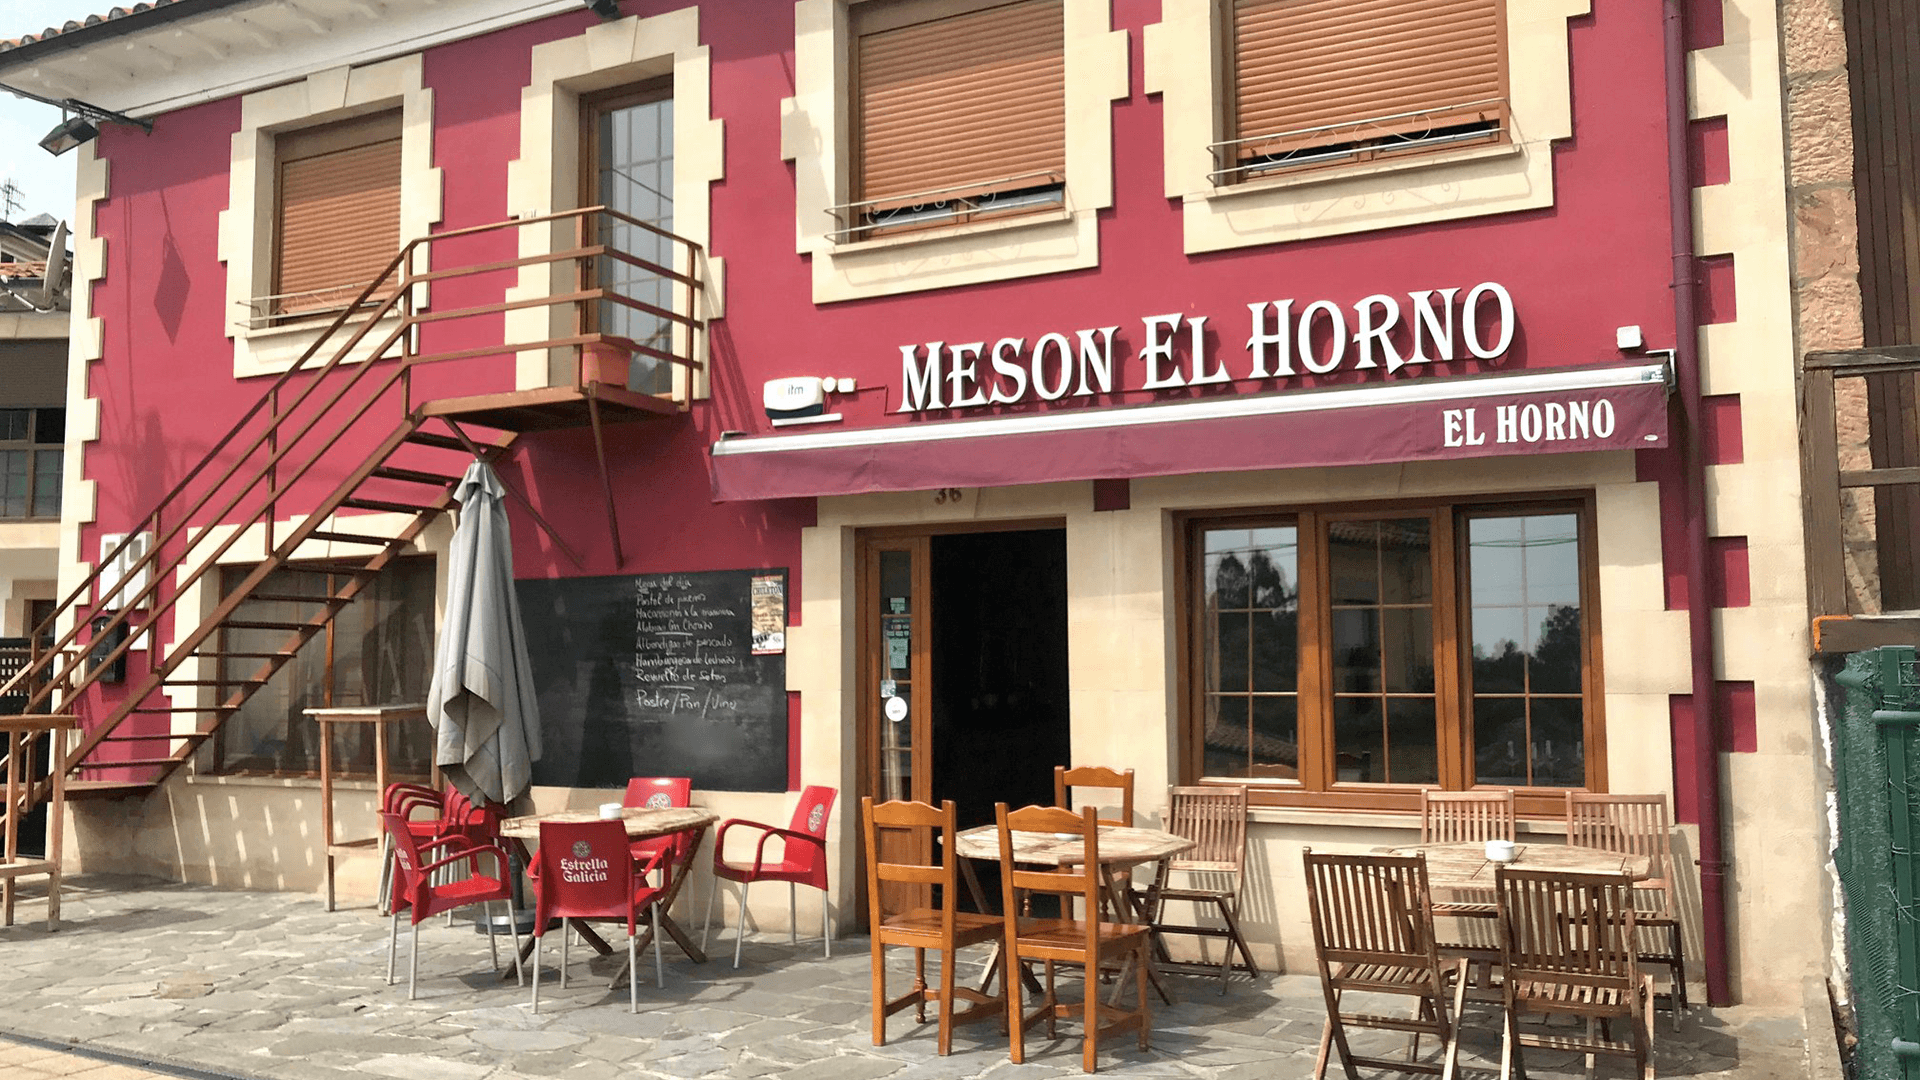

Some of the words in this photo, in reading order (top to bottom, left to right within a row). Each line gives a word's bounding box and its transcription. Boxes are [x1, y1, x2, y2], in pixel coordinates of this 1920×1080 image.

[897, 325, 1120, 412] MESON
[1139, 312, 1231, 390] EL
[1246, 282, 1515, 380] HORNO
[1443, 408, 1486, 448] EL
[1496, 399, 1616, 443] HORNO
[682, 667, 697, 682] de
[560, 858, 608, 870] Estrella
[562, 870, 608, 883] Galicia
